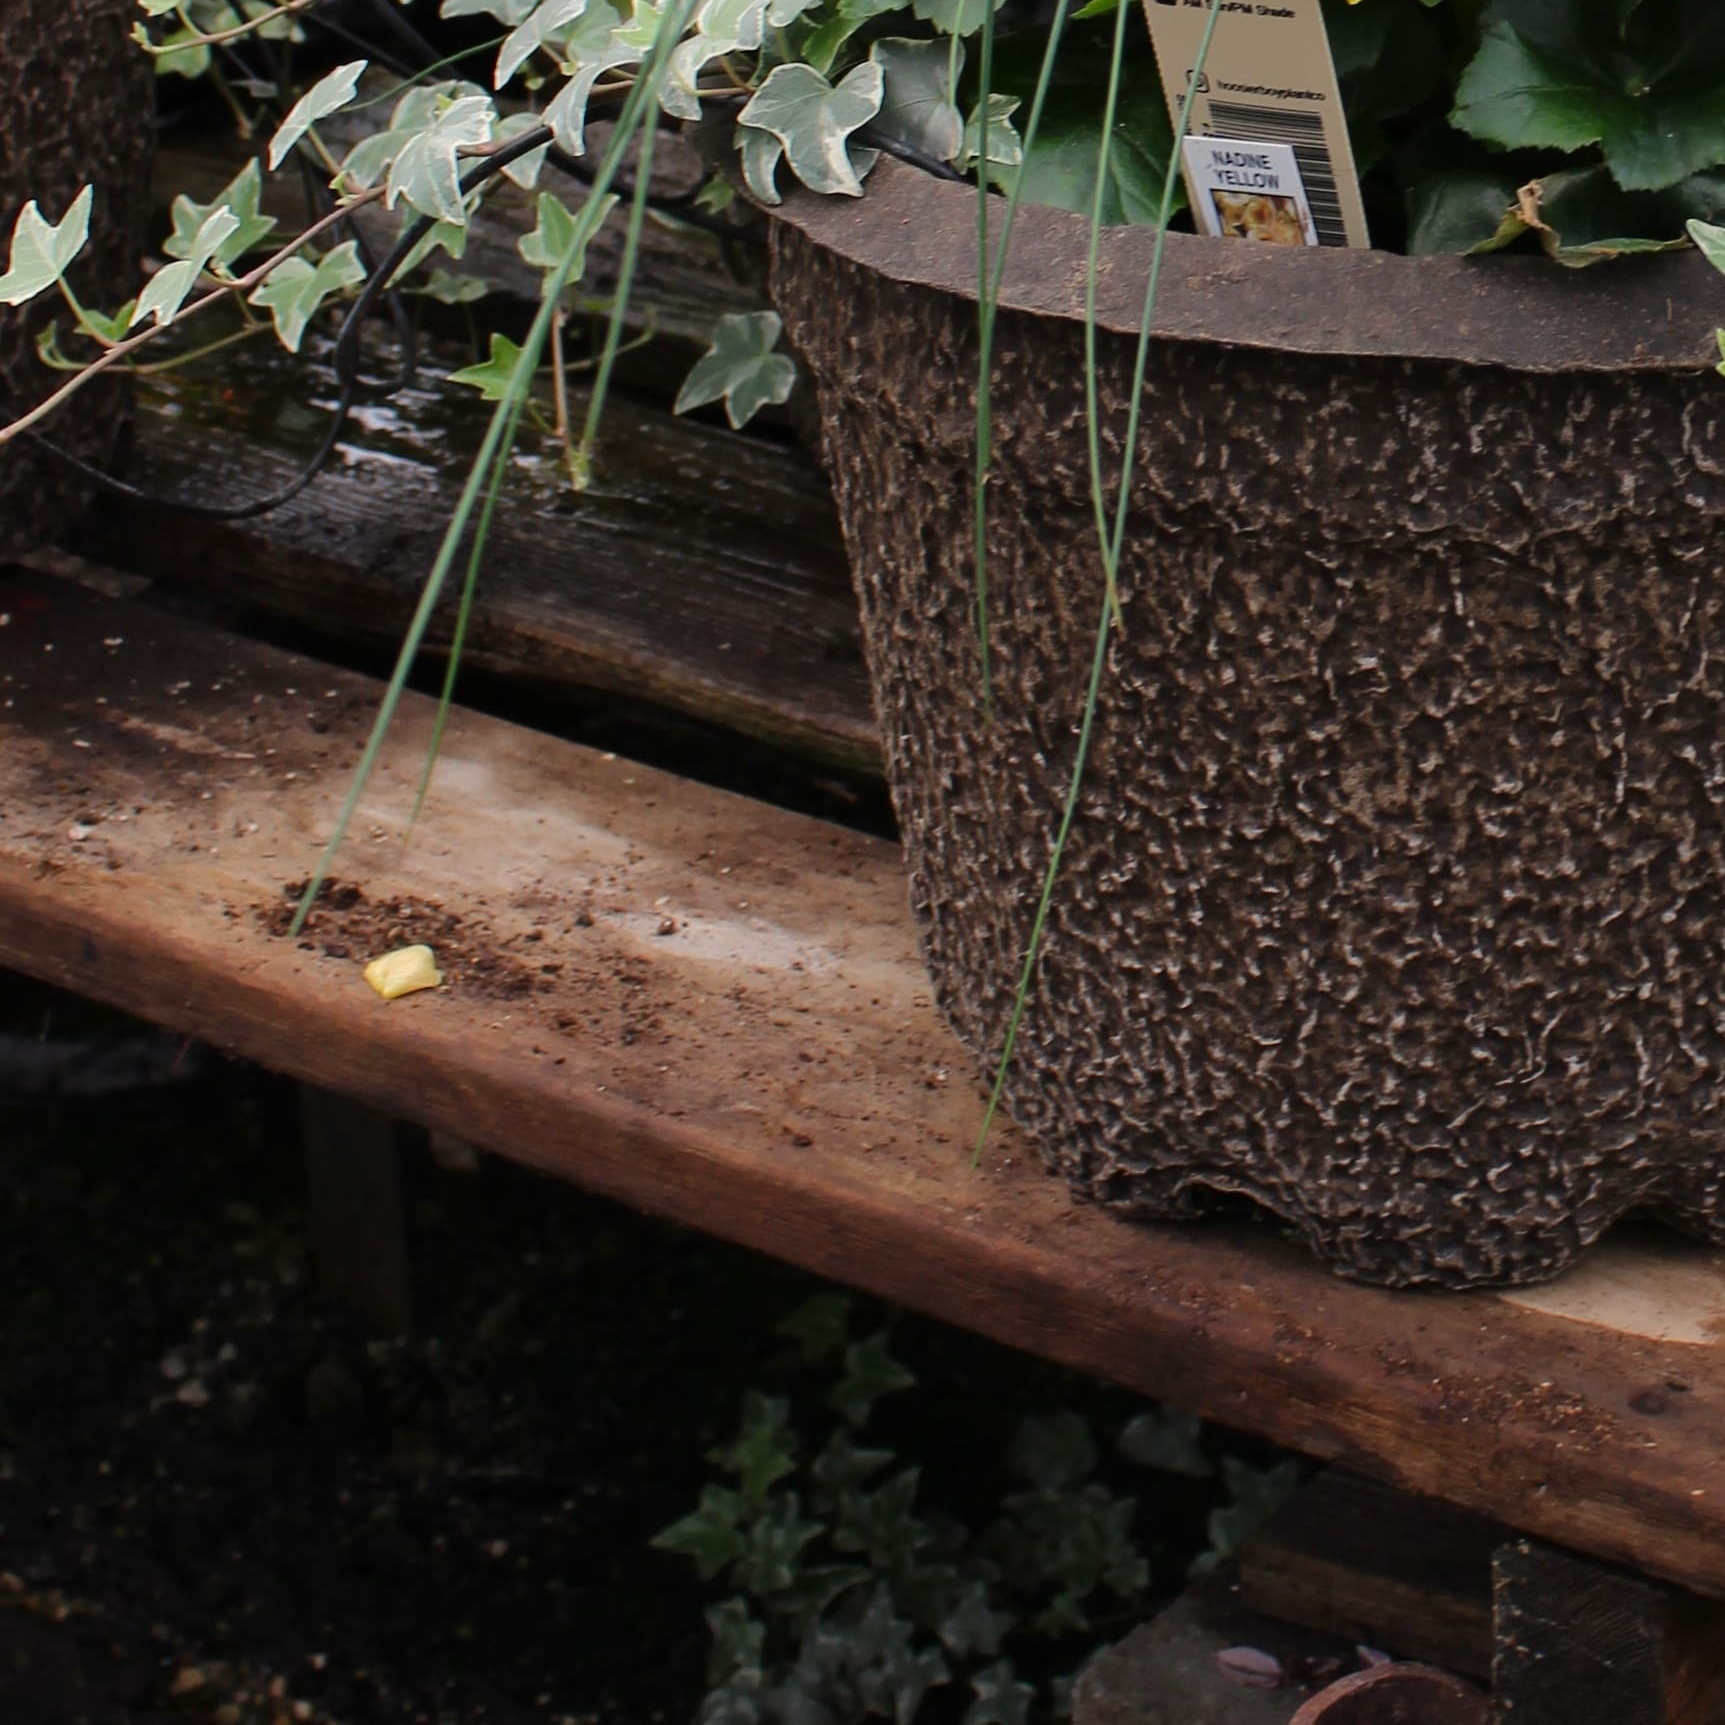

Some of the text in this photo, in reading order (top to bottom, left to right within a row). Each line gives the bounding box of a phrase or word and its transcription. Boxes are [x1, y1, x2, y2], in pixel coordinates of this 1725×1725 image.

[1256, 4, 1296, 19] Shade
[1212, 150, 1273, 170] NADINE
[1215, 170, 1280, 189] YELLOW
